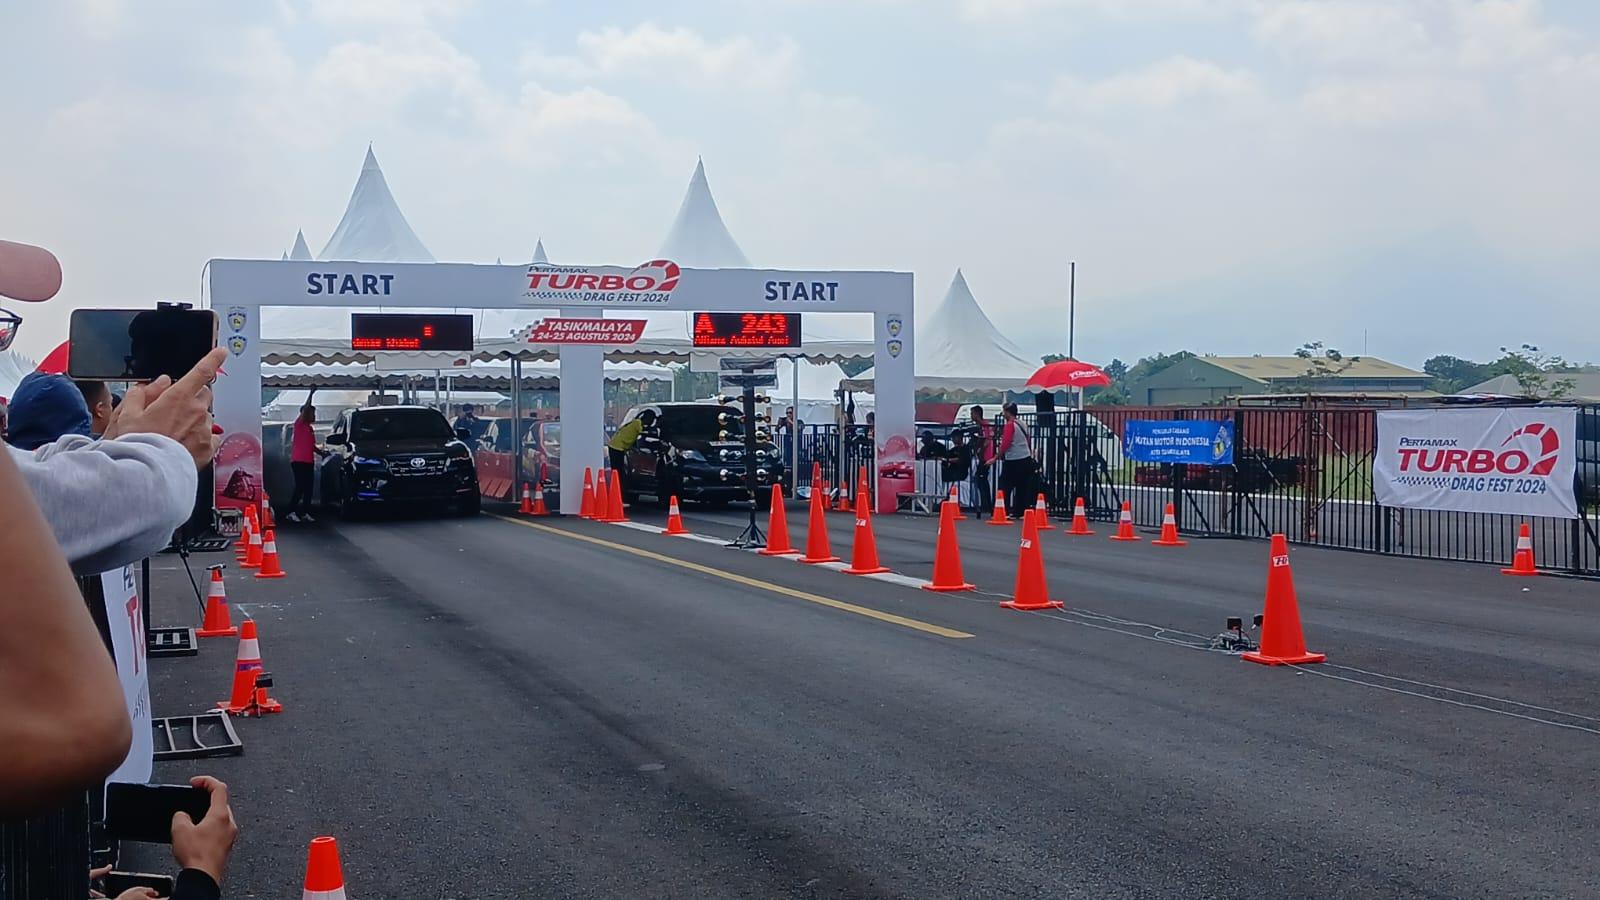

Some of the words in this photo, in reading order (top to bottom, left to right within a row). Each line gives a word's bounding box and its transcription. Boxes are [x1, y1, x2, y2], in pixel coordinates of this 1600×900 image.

[528, 265, 589, 274] PERTAMAX
[307, 273, 394, 295] START
[526, 274, 656, 291] TURBO
[583, 292, 614, 302] DRAG
[616, 292, 641, 302] FEST
[642, 293, 671, 303] 2024
[765, 280, 838, 301] START
[549, 321, 633, 332] TASIKMALAYA
[695, 313, 714, 333] A
[741, 313, 786, 333] 243
[537, 332, 564, 341] 24-25
[566, 332, 610, 341] AGUSTUS
[611, 333, 636, 341] 2024
[1154, 436, 1174, 446] MOTOR
[1399, 437, 1458, 447] PERTAMAX
[1398, 449, 1530, 475] TURBO
[1451, 477, 1485, 491] DRAG
[1487, 478, 1514, 492] FEST
[1515, 478, 1546, 494] 2024
